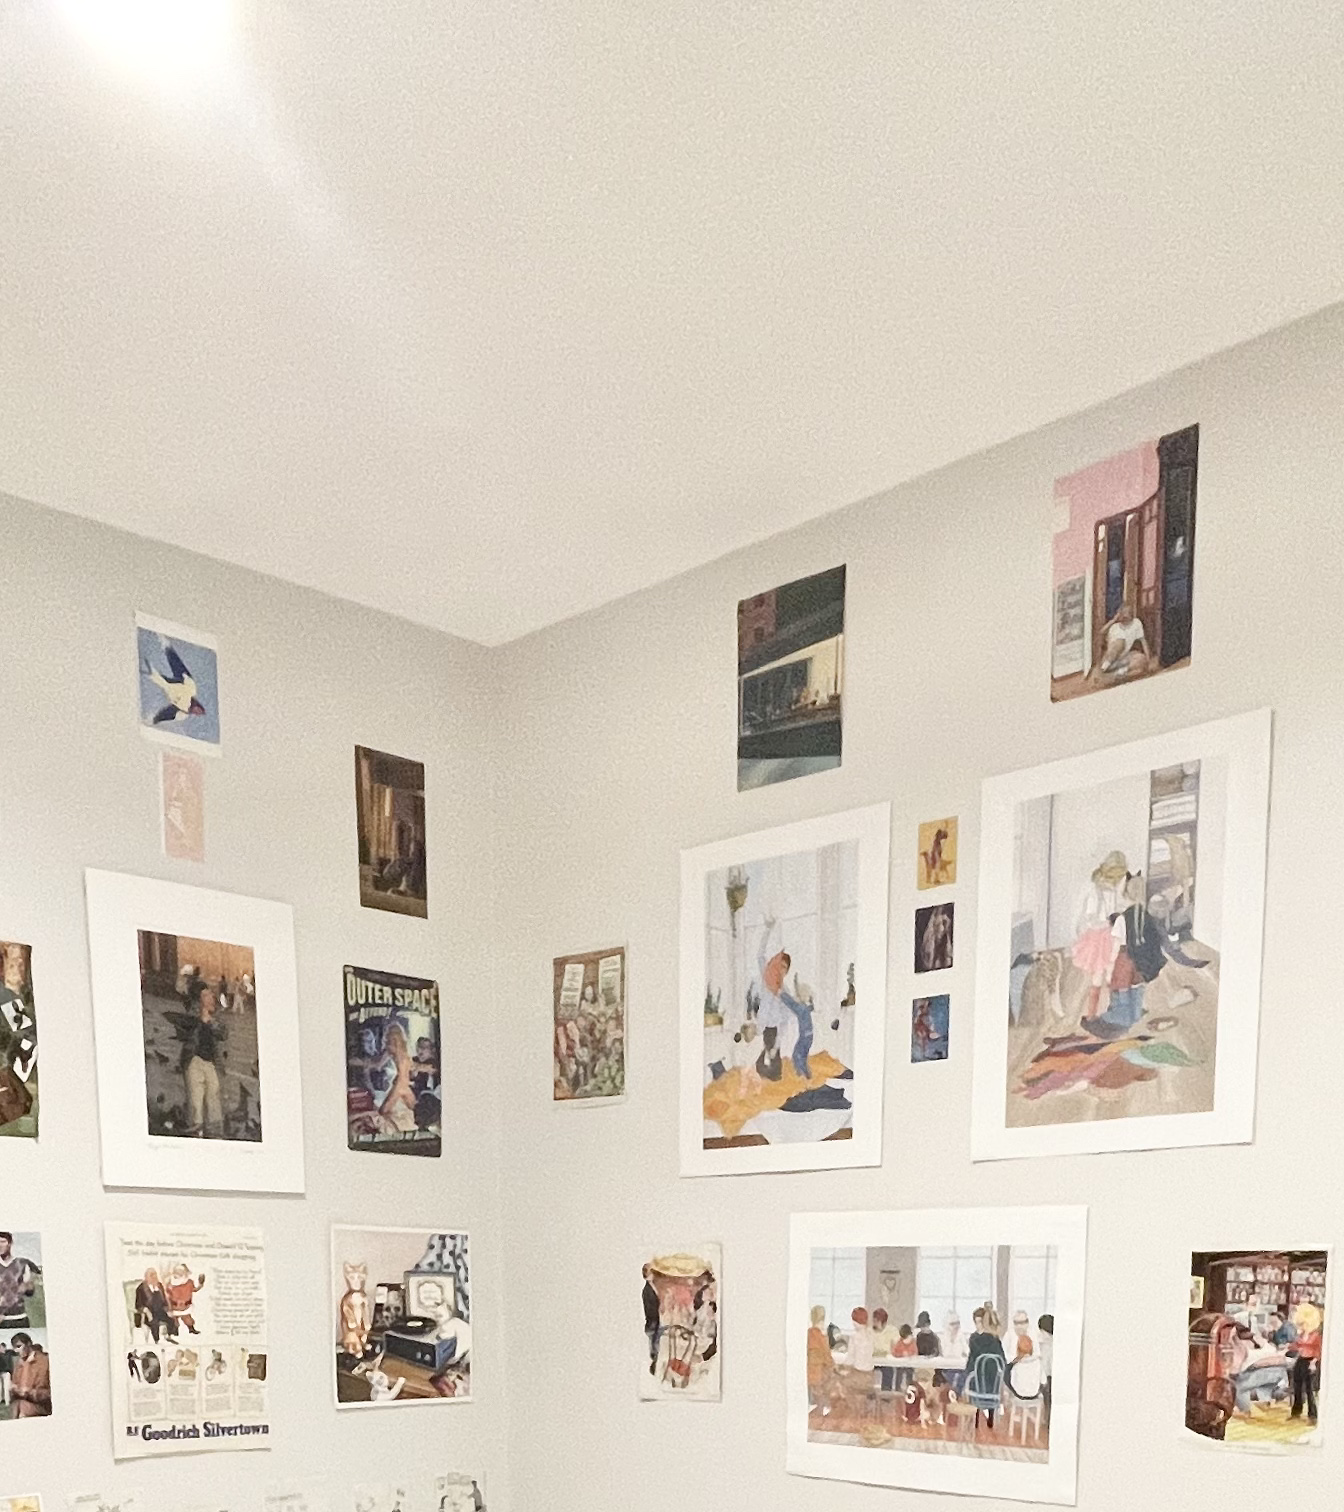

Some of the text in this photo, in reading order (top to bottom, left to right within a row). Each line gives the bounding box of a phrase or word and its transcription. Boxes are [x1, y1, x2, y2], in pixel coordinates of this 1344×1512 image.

[345, 972, 393, 1007] OUTER
[394, 985, 439, 1020] SPACE
[904, 1384, 917, 1405] 5
[141, 1423, 201, 1441] Goodrich
[202, 1421, 270, 1438] Silvertown
